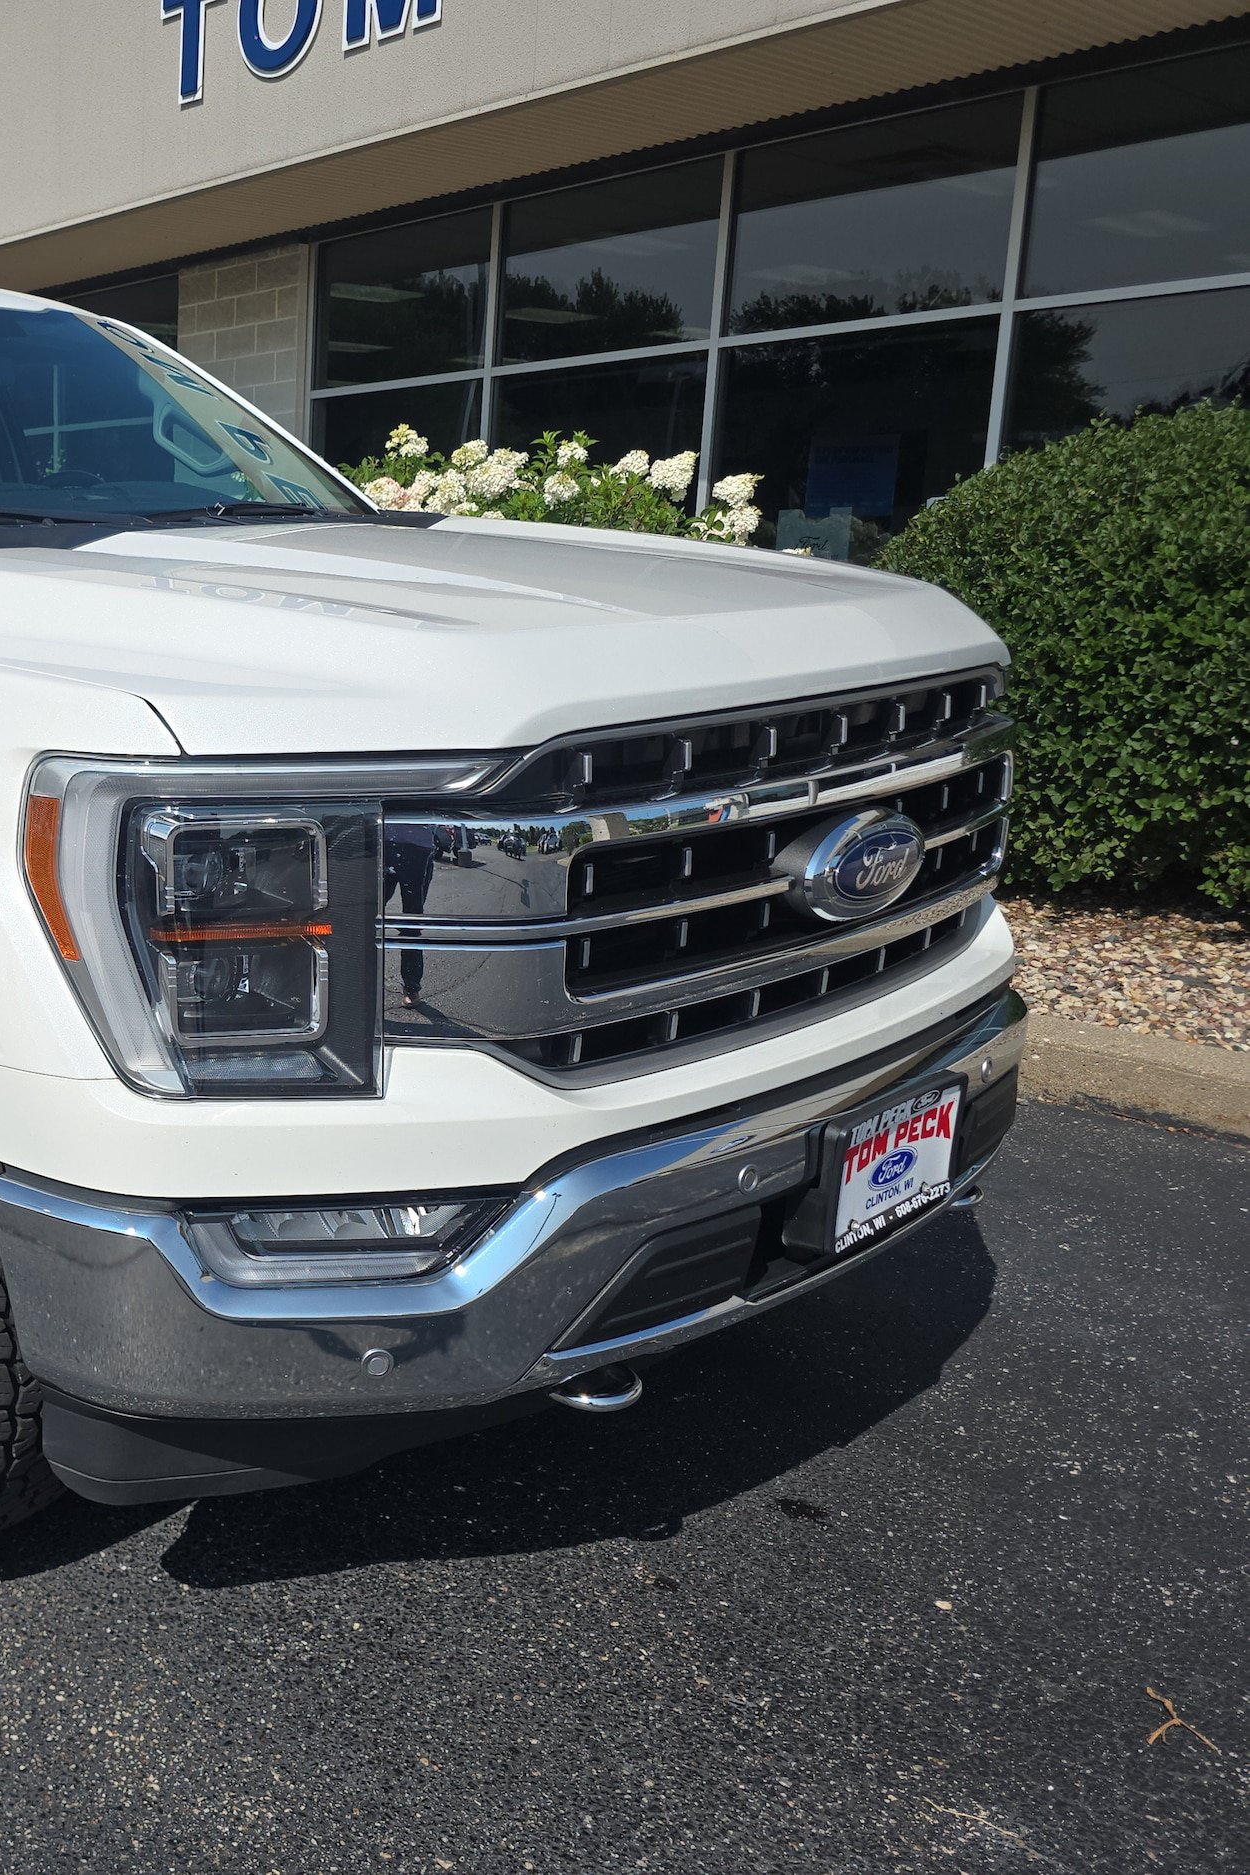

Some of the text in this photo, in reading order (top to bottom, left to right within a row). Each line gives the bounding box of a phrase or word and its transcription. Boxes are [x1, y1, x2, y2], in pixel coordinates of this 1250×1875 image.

[855, 841, 910, 891] Ford
[844, 1100, 955, 1186] TOM PECK
[877, 1154, 908, 1183] Ford
[865, 1177, 914, 1210] CLINTON, WI
[874, 1214, 887, 1232] WI
